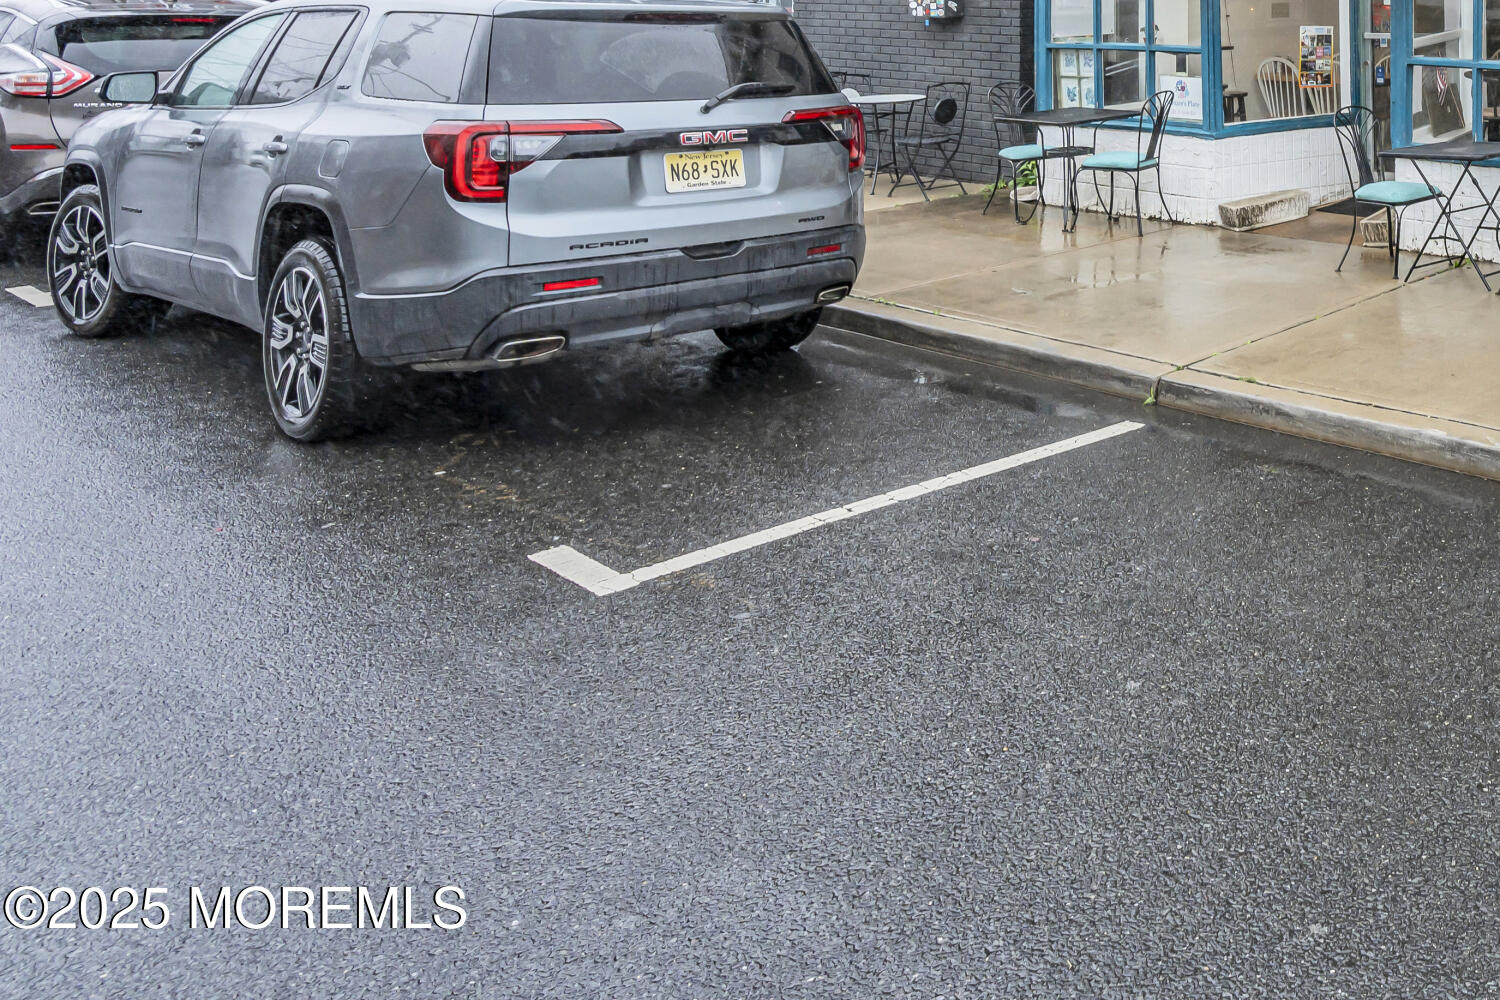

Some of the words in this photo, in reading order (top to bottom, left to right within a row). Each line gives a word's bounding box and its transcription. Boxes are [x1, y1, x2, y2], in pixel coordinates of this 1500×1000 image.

[680, 129, 748, 146] GMC
[703, 152, 723, 160] Jersey
[798, 215, 825, 223] AWD
[569, 238, 649, 250] ACADIA
